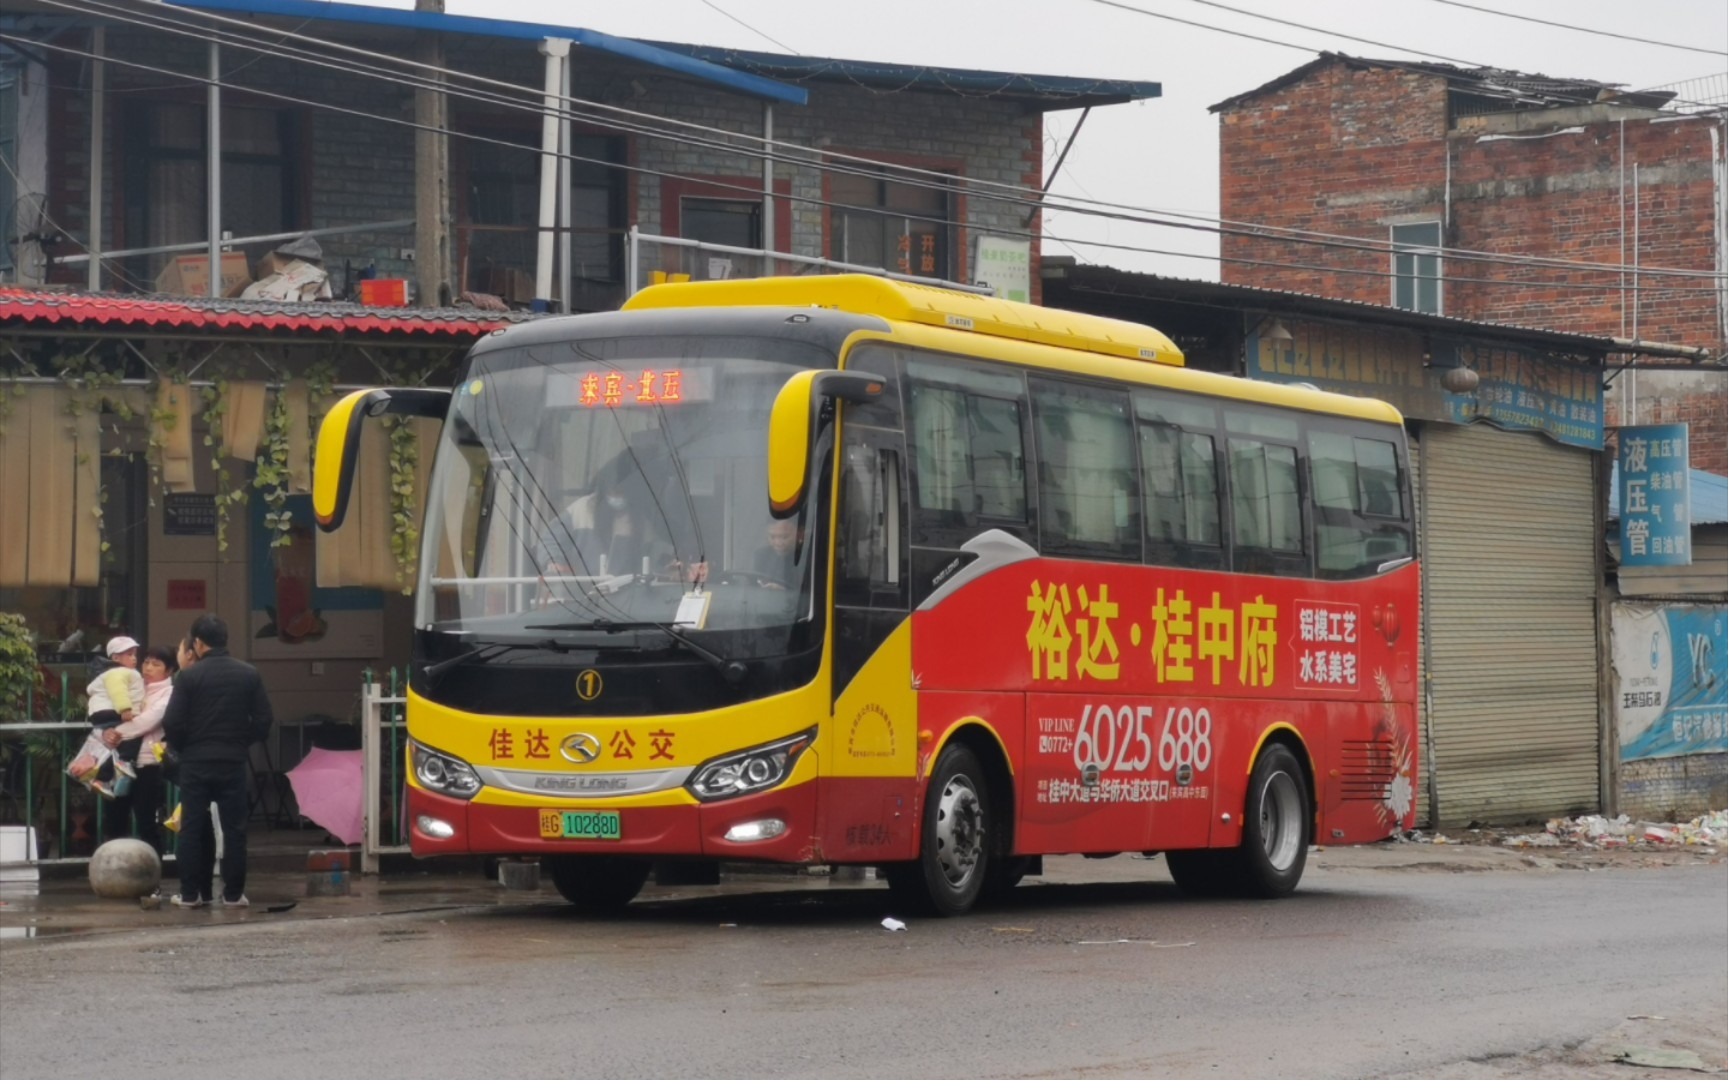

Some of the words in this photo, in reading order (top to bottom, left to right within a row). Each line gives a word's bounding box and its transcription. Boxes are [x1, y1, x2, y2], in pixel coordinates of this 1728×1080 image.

[1649, 438, 1683, 458] 高压管
[1650, 471, 1684, 491] 柴油管
[1624, 437, 1649, 555] 液压管
[1652, 536, 1686, 554] 回油管
[1026, 579, 1278, 687] 裕达·桂中府
[1300, 608, 1357, 643] 铝模工艺
[1300, 649, 1357, 685] 水系美宅
[1039, 717, 1054, 732] VIP
[1054, 718, 1075, 733] LINE
[1073, 704, 1153, 771] 6025
[1158, 707, 1212, 771] 688
[488, 728, 551, 760] 佳达
[609, 729, 676, 760] 公交
[534, 776, 577, 789] KING
[579, 776, 628, 789] LONG
[1049, 778, 1169, 803] 桂中大道与华侨大道交叉口
[541, 814, 559, 833] 桂G
[567, 815, 618, 834] 10288D
